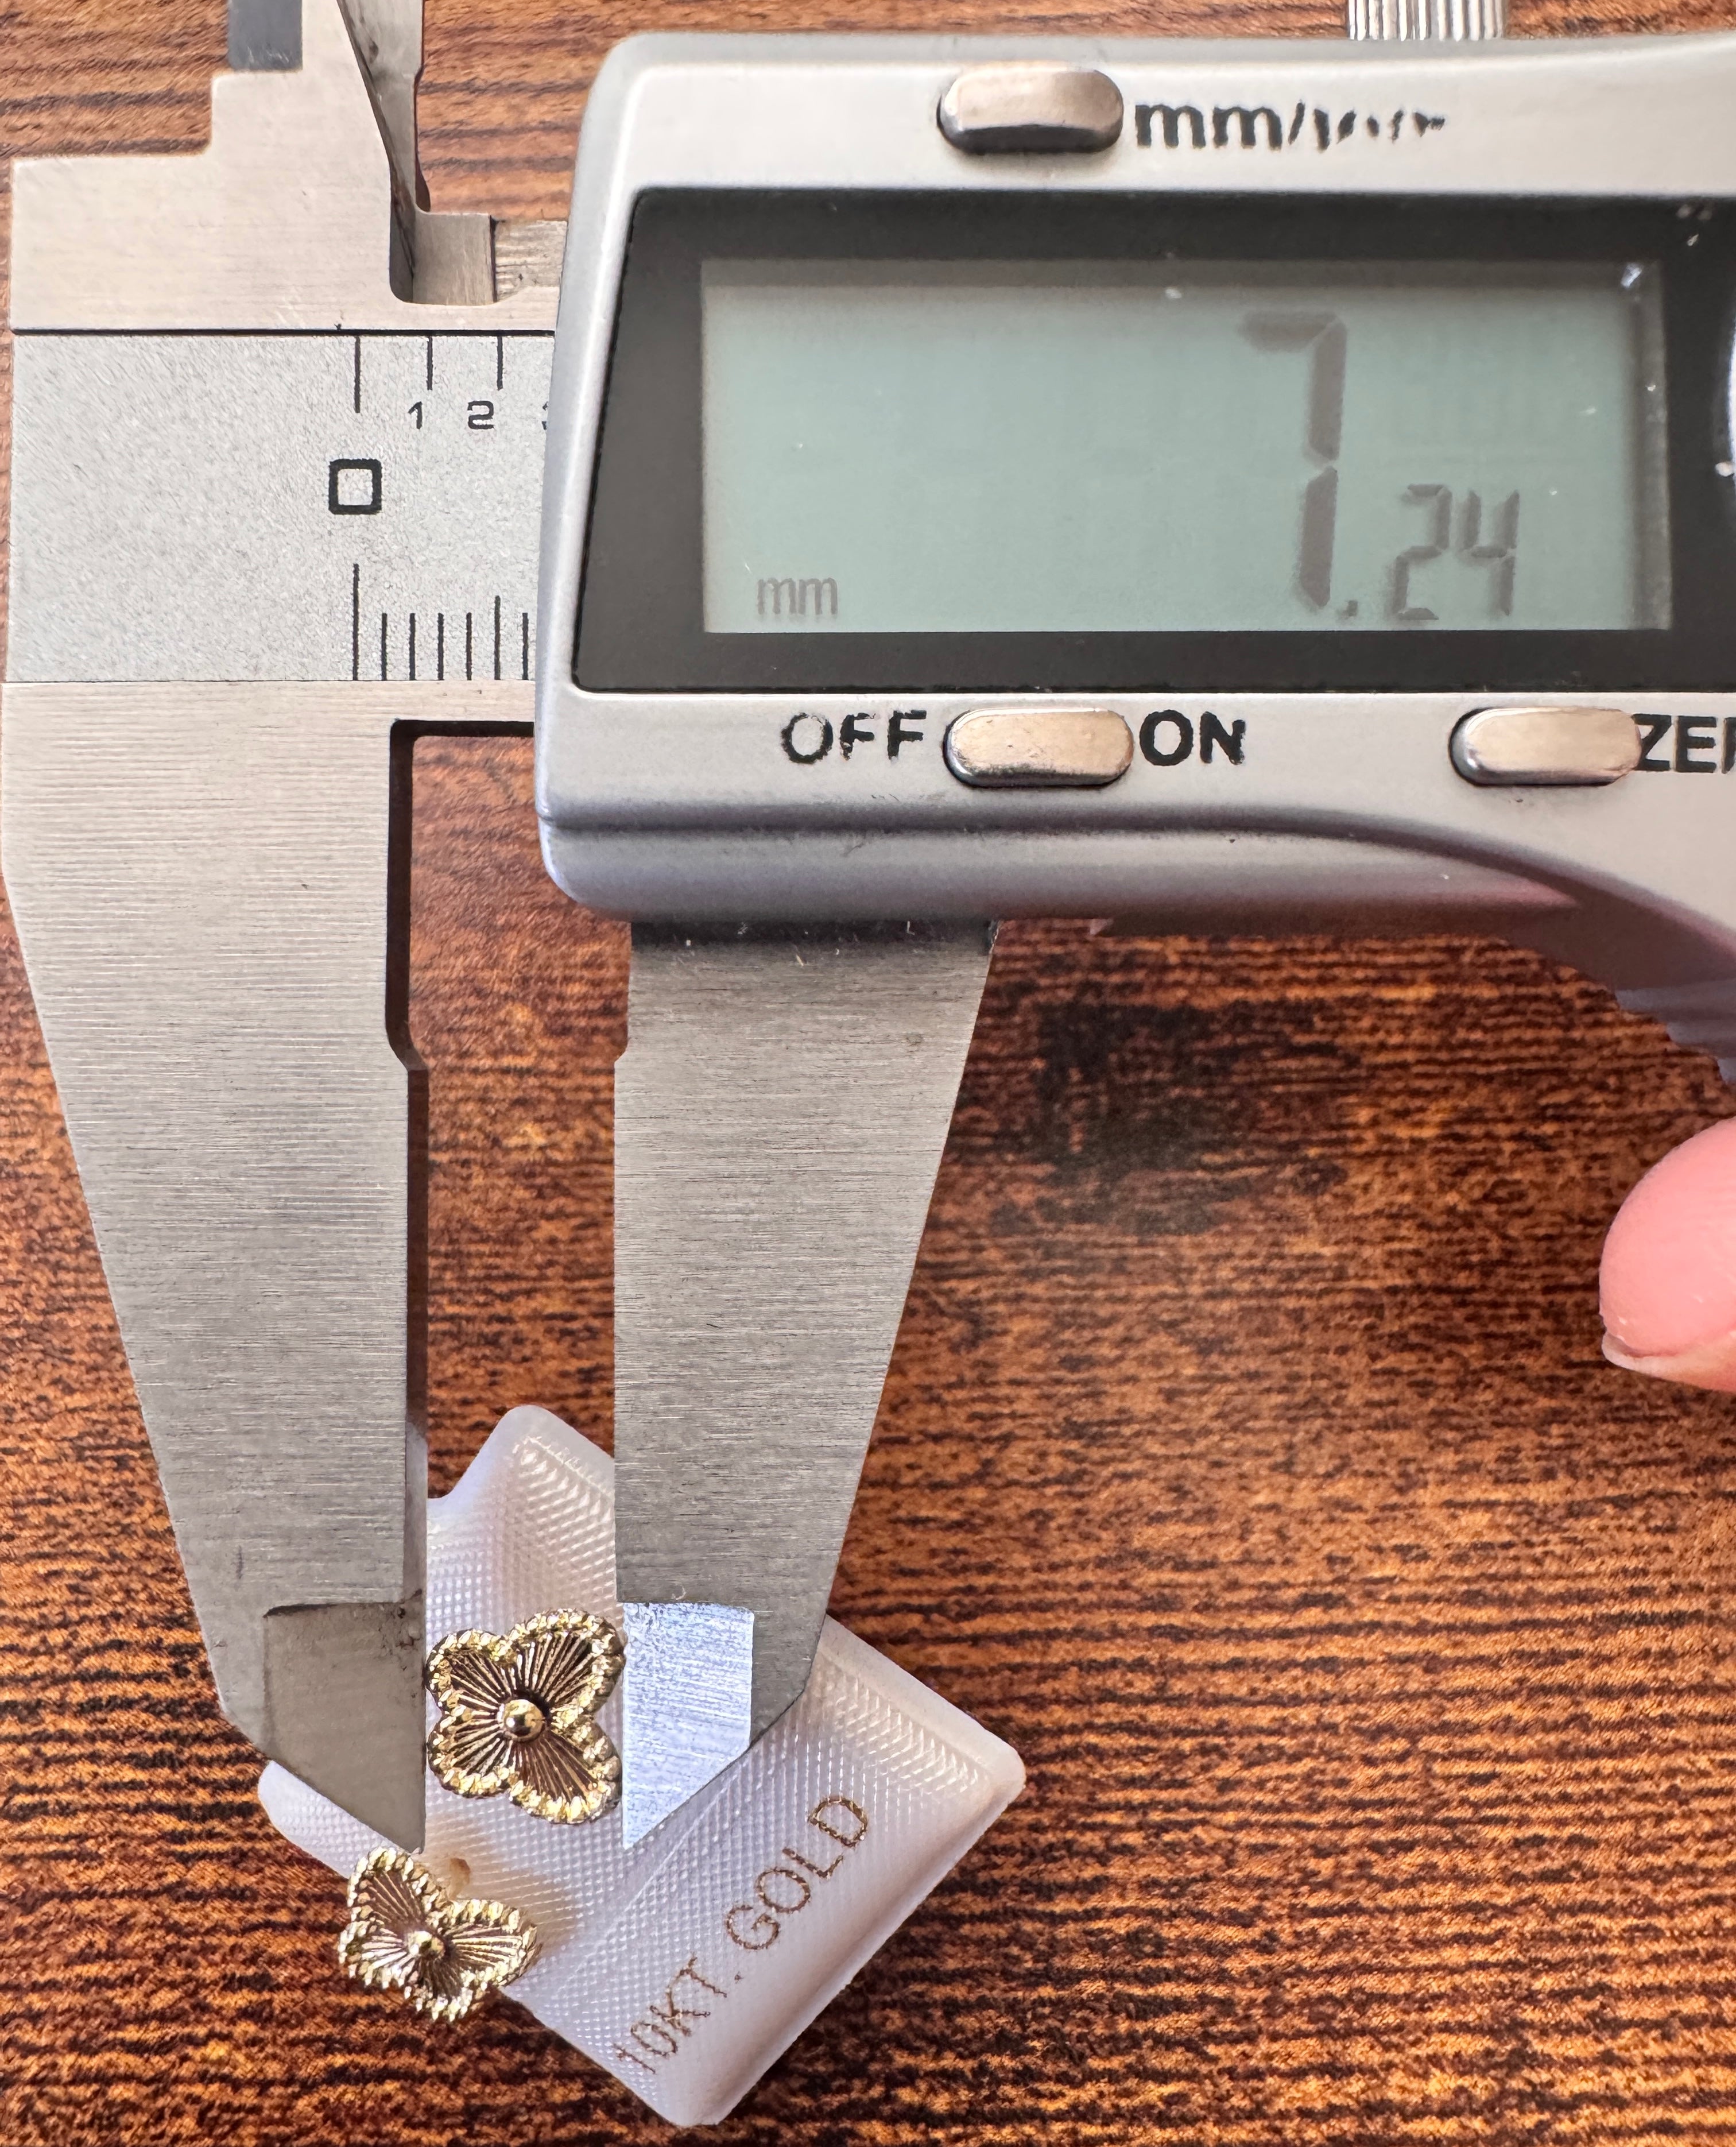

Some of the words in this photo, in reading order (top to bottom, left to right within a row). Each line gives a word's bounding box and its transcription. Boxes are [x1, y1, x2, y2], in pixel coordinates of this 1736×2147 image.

[408, 401, 423, 429] 1
[467, 400, 495, 429] 2
[1237, 311, 1521, 620] 7.24
[757, 576, 839, 616] mm
[781, 710, 928, 764] OFF
[1139, 709, 1246, 766] ON
[725, 1795, 869, 1950] GOLD
